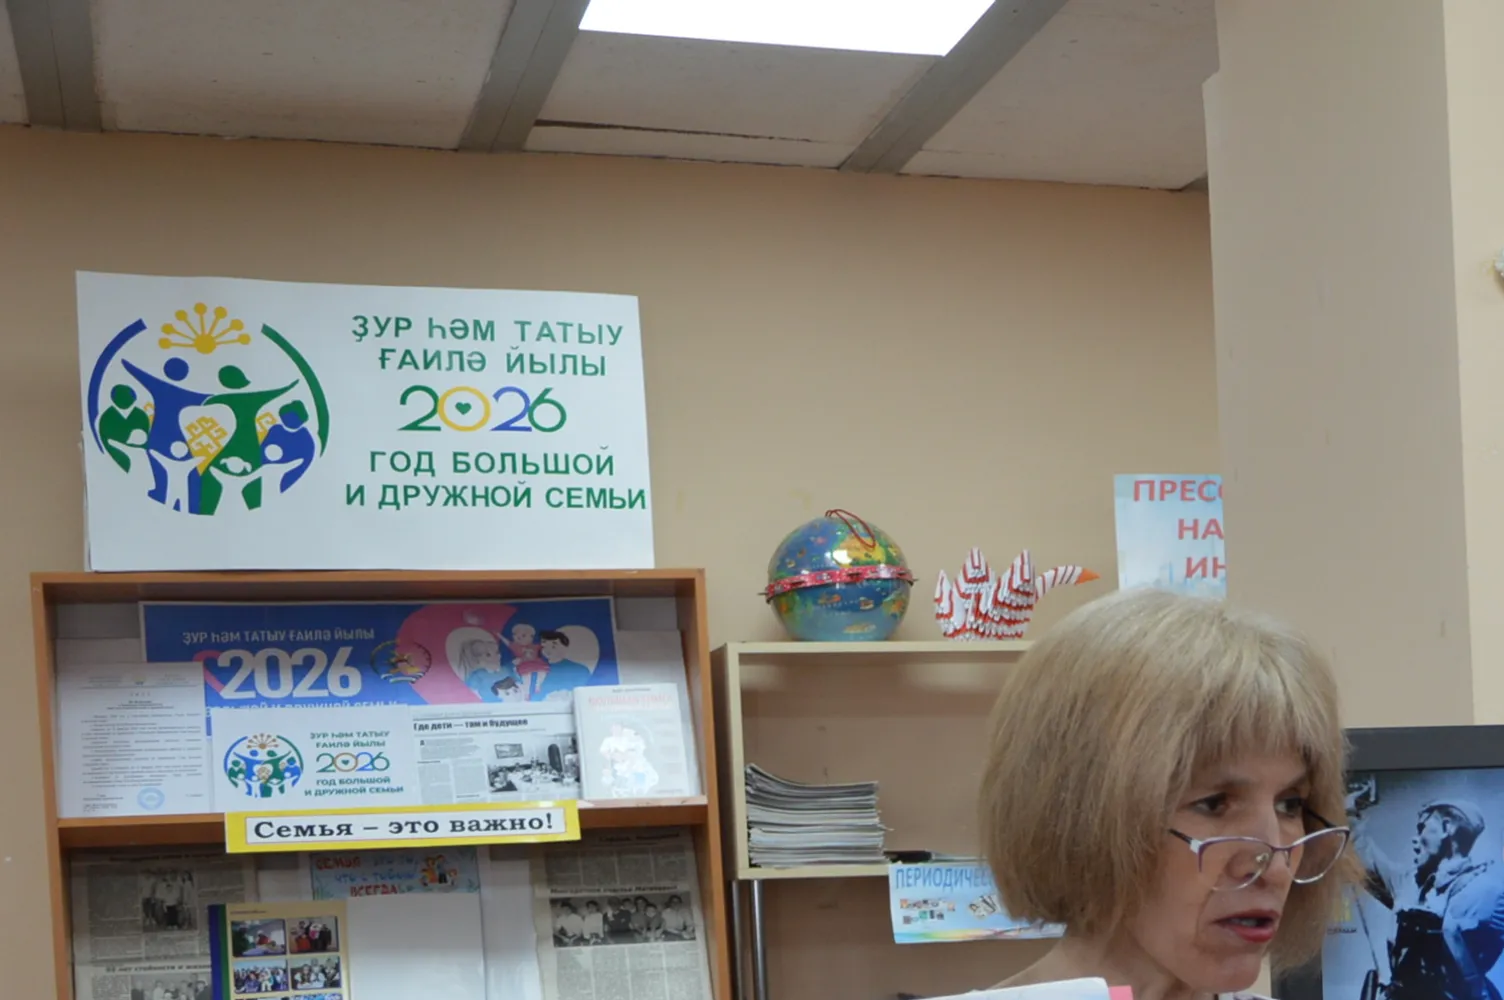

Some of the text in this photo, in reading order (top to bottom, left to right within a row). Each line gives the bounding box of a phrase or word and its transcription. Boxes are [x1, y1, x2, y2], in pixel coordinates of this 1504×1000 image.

[514, 320, 624, 345] ТАТЫУ
[506, 346, 606, 376] ЙЫЛЫ
[397, 385, 567, 432] 2026
[370, 446, 614, 477] ГОД БОЛЬШОЙ
[346, 481, 647, 510] И ДРУЖНОЙ СЕМЬИ
[1134, 480, 1223, 502] ПРЕС
[217, 647, 362, 699] 2026
[316, 752, 390, 772] 2026
[339, 776, 391, 785] БОЛЬШОЙ
[254, 820, 353, 839] Семья
[389, 821, 439, 835] это
[450, 812, 553, 832] важно!
